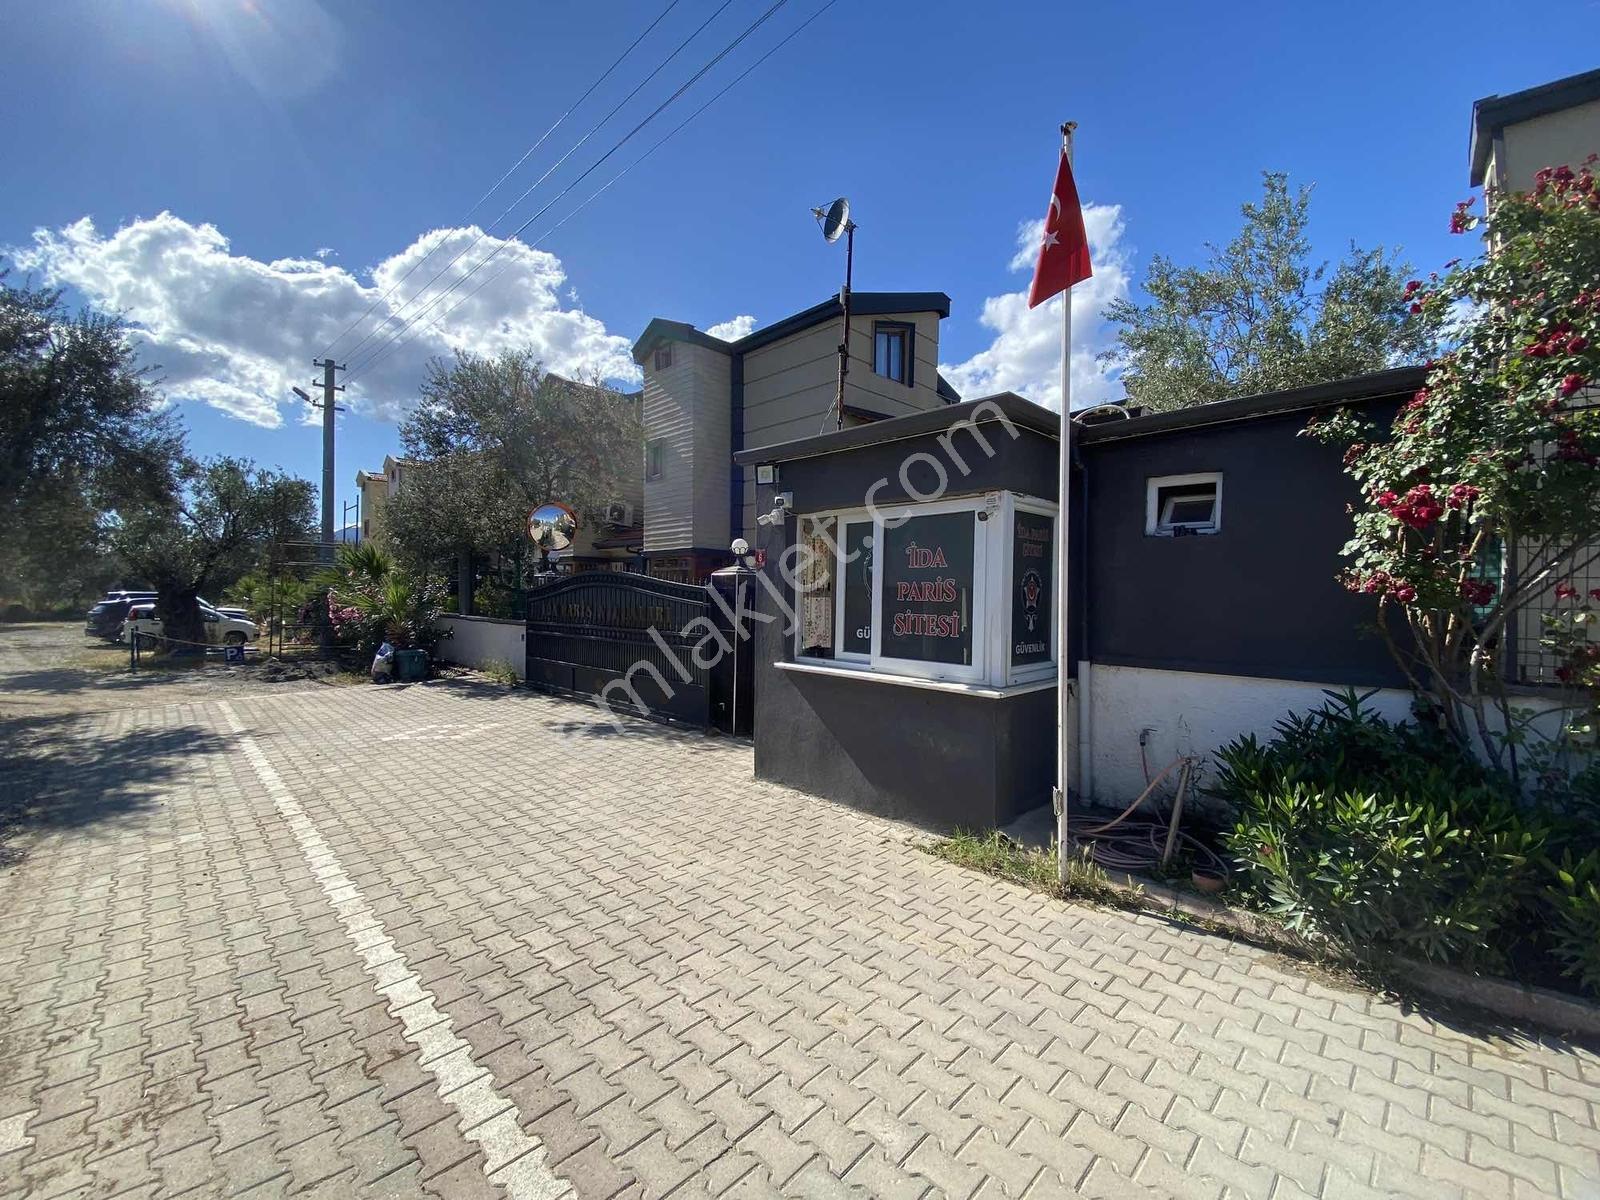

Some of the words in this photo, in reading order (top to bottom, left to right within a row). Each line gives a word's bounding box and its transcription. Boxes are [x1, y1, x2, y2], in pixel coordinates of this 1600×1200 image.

[906, 541, 948, 569] İDA
[896, 575, 958, 603] PARİS
[893, 610, 961, 639] SİTESİ
[226, 648, 238, 661] P
